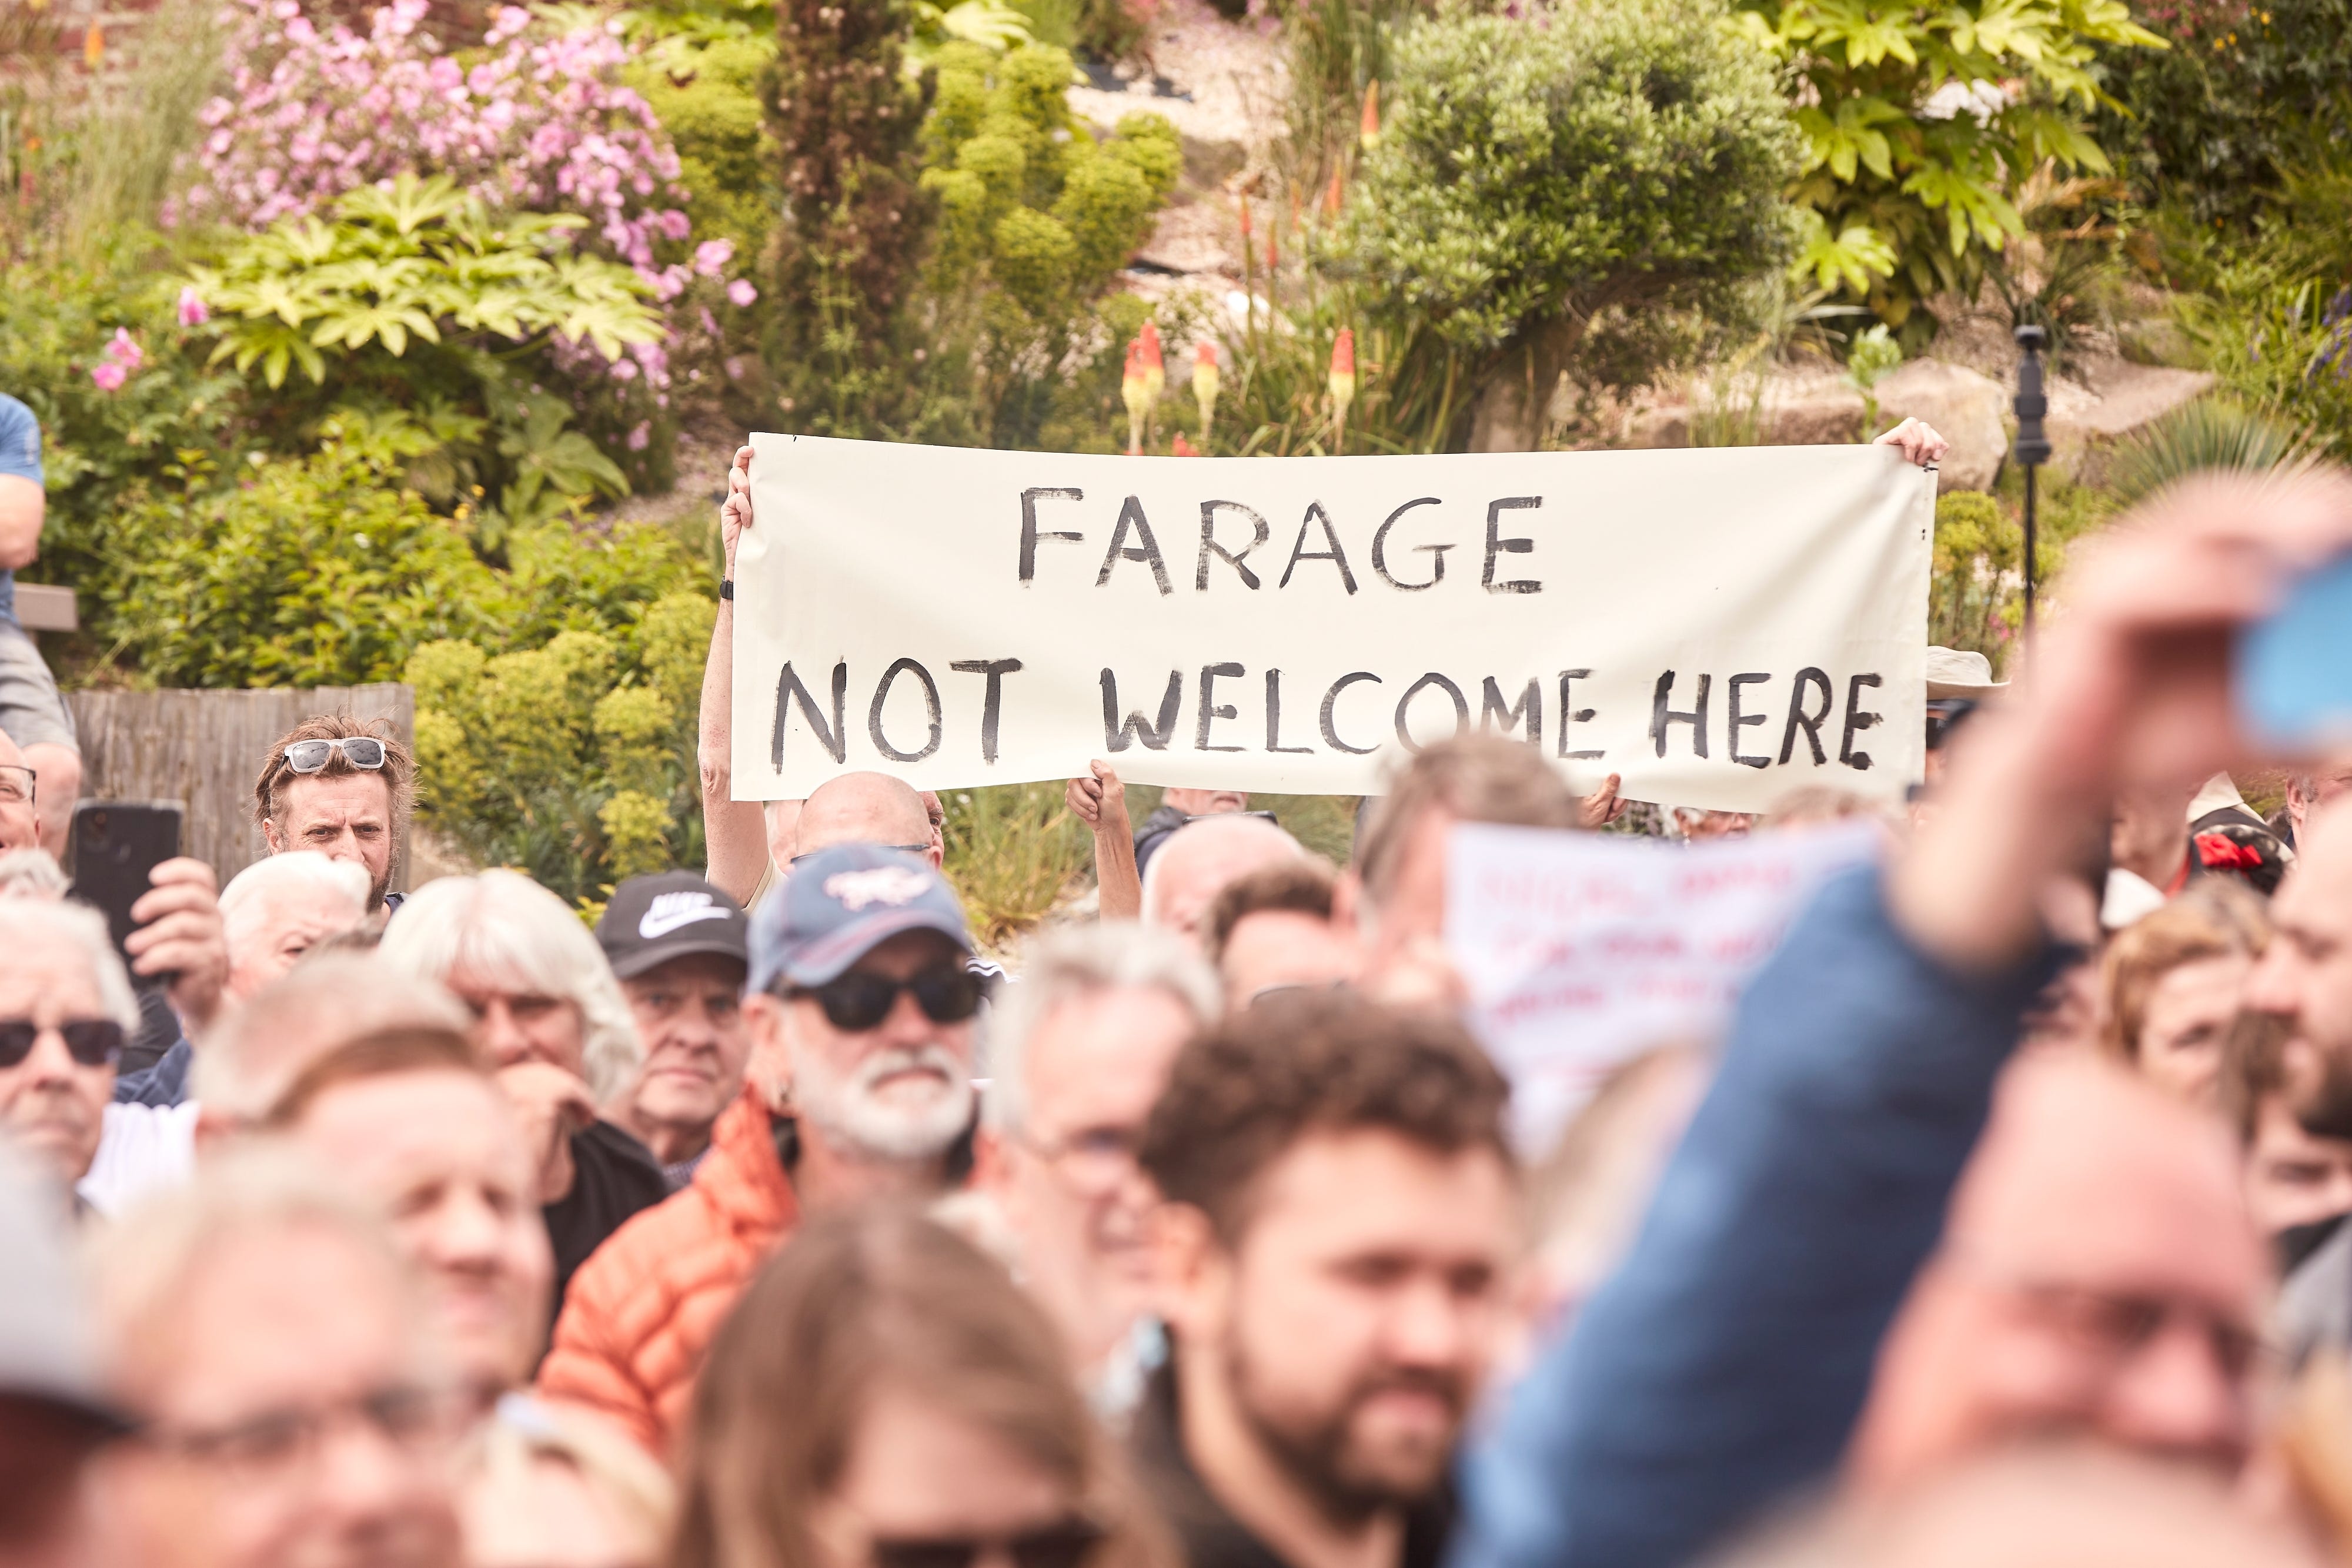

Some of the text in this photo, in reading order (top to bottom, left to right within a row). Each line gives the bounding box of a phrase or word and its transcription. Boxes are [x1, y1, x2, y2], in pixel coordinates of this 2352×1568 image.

[1018, 487, 1543, 596] FARAGE
[771, 656, 1883, 775] NOT WELCOME HERE
